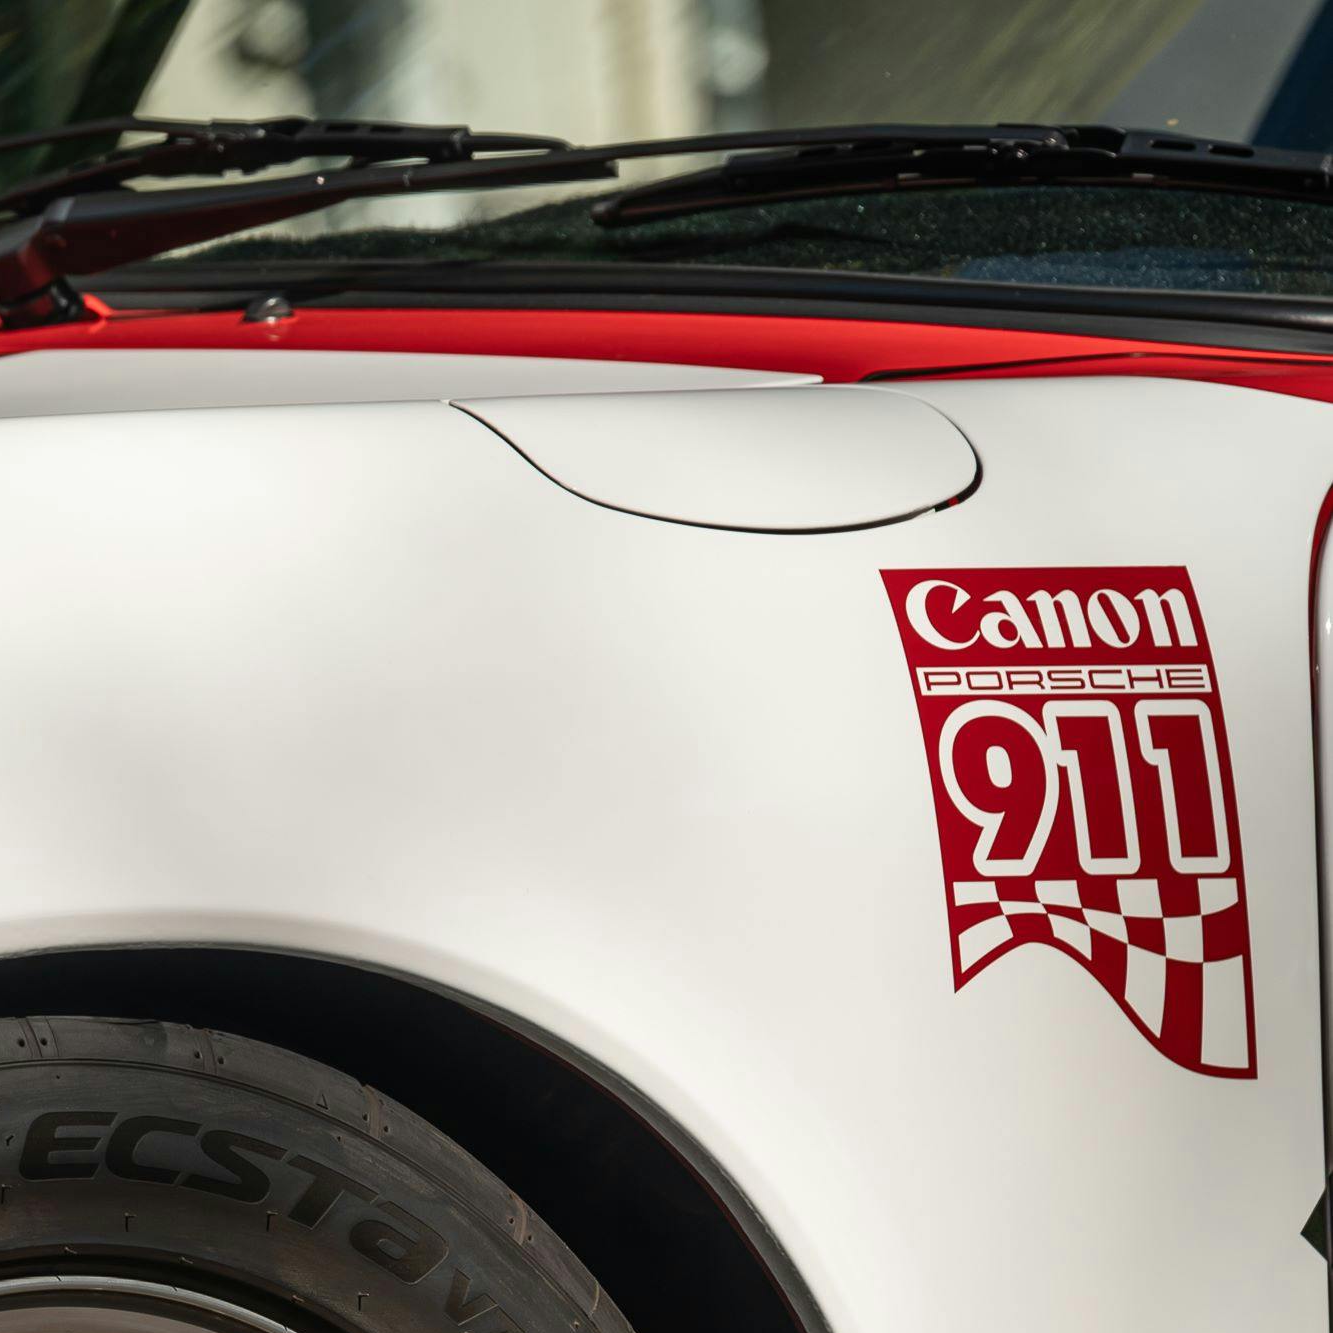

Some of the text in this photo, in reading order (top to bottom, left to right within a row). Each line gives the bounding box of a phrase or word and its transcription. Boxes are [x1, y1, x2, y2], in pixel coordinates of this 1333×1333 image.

[906, 579, 1198, 650] Canon
[923, 668, 1206, 691] PORSCHE
[938, 699, 1231, 876] 911
